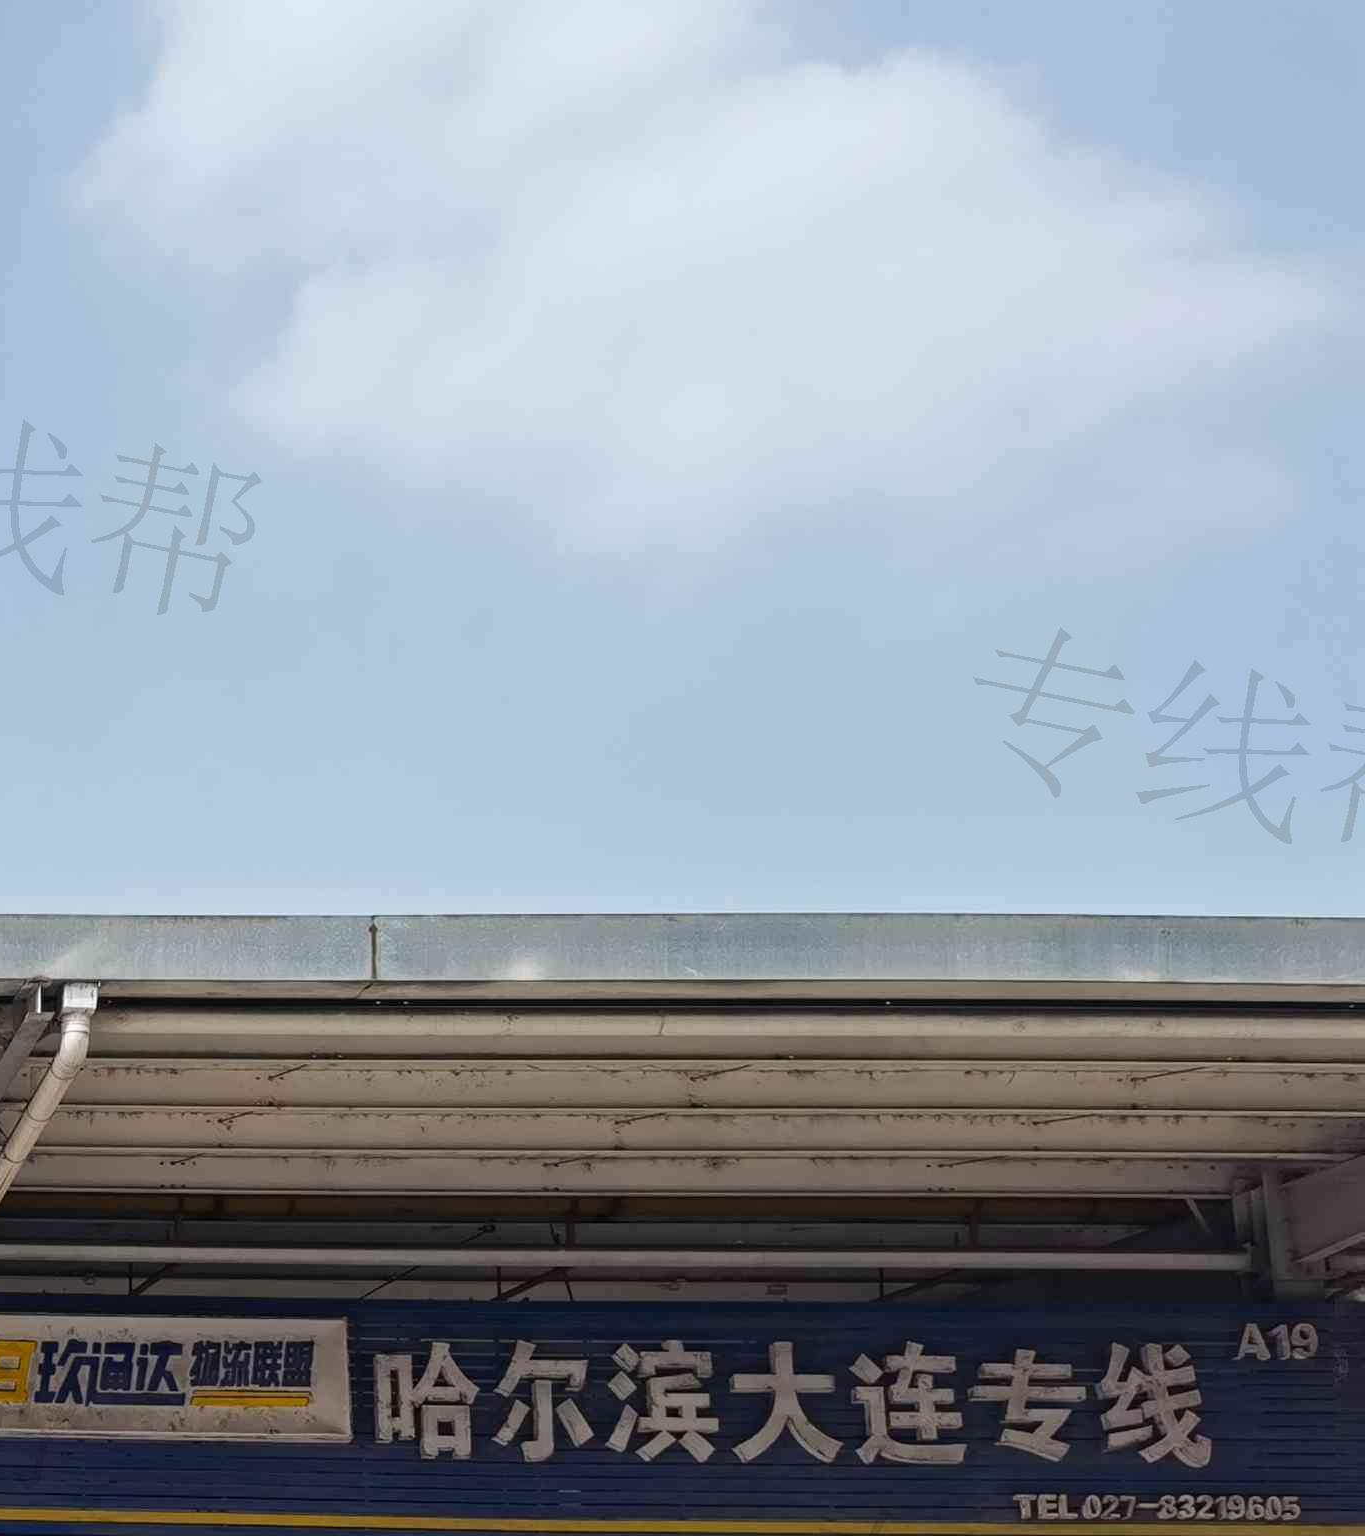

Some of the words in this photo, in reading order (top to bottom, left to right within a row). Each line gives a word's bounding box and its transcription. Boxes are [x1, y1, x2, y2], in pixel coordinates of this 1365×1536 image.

[1234, 1323, 1319, 1360] A19
[37, 1340, 185, 1406] 玖通达
[189, 1340, 314, 1388] 物流联盟
[373, 1340, 1212, 1468] 哈尔滨大连专线
[1013, 1494, 1078, 1521] TEL
